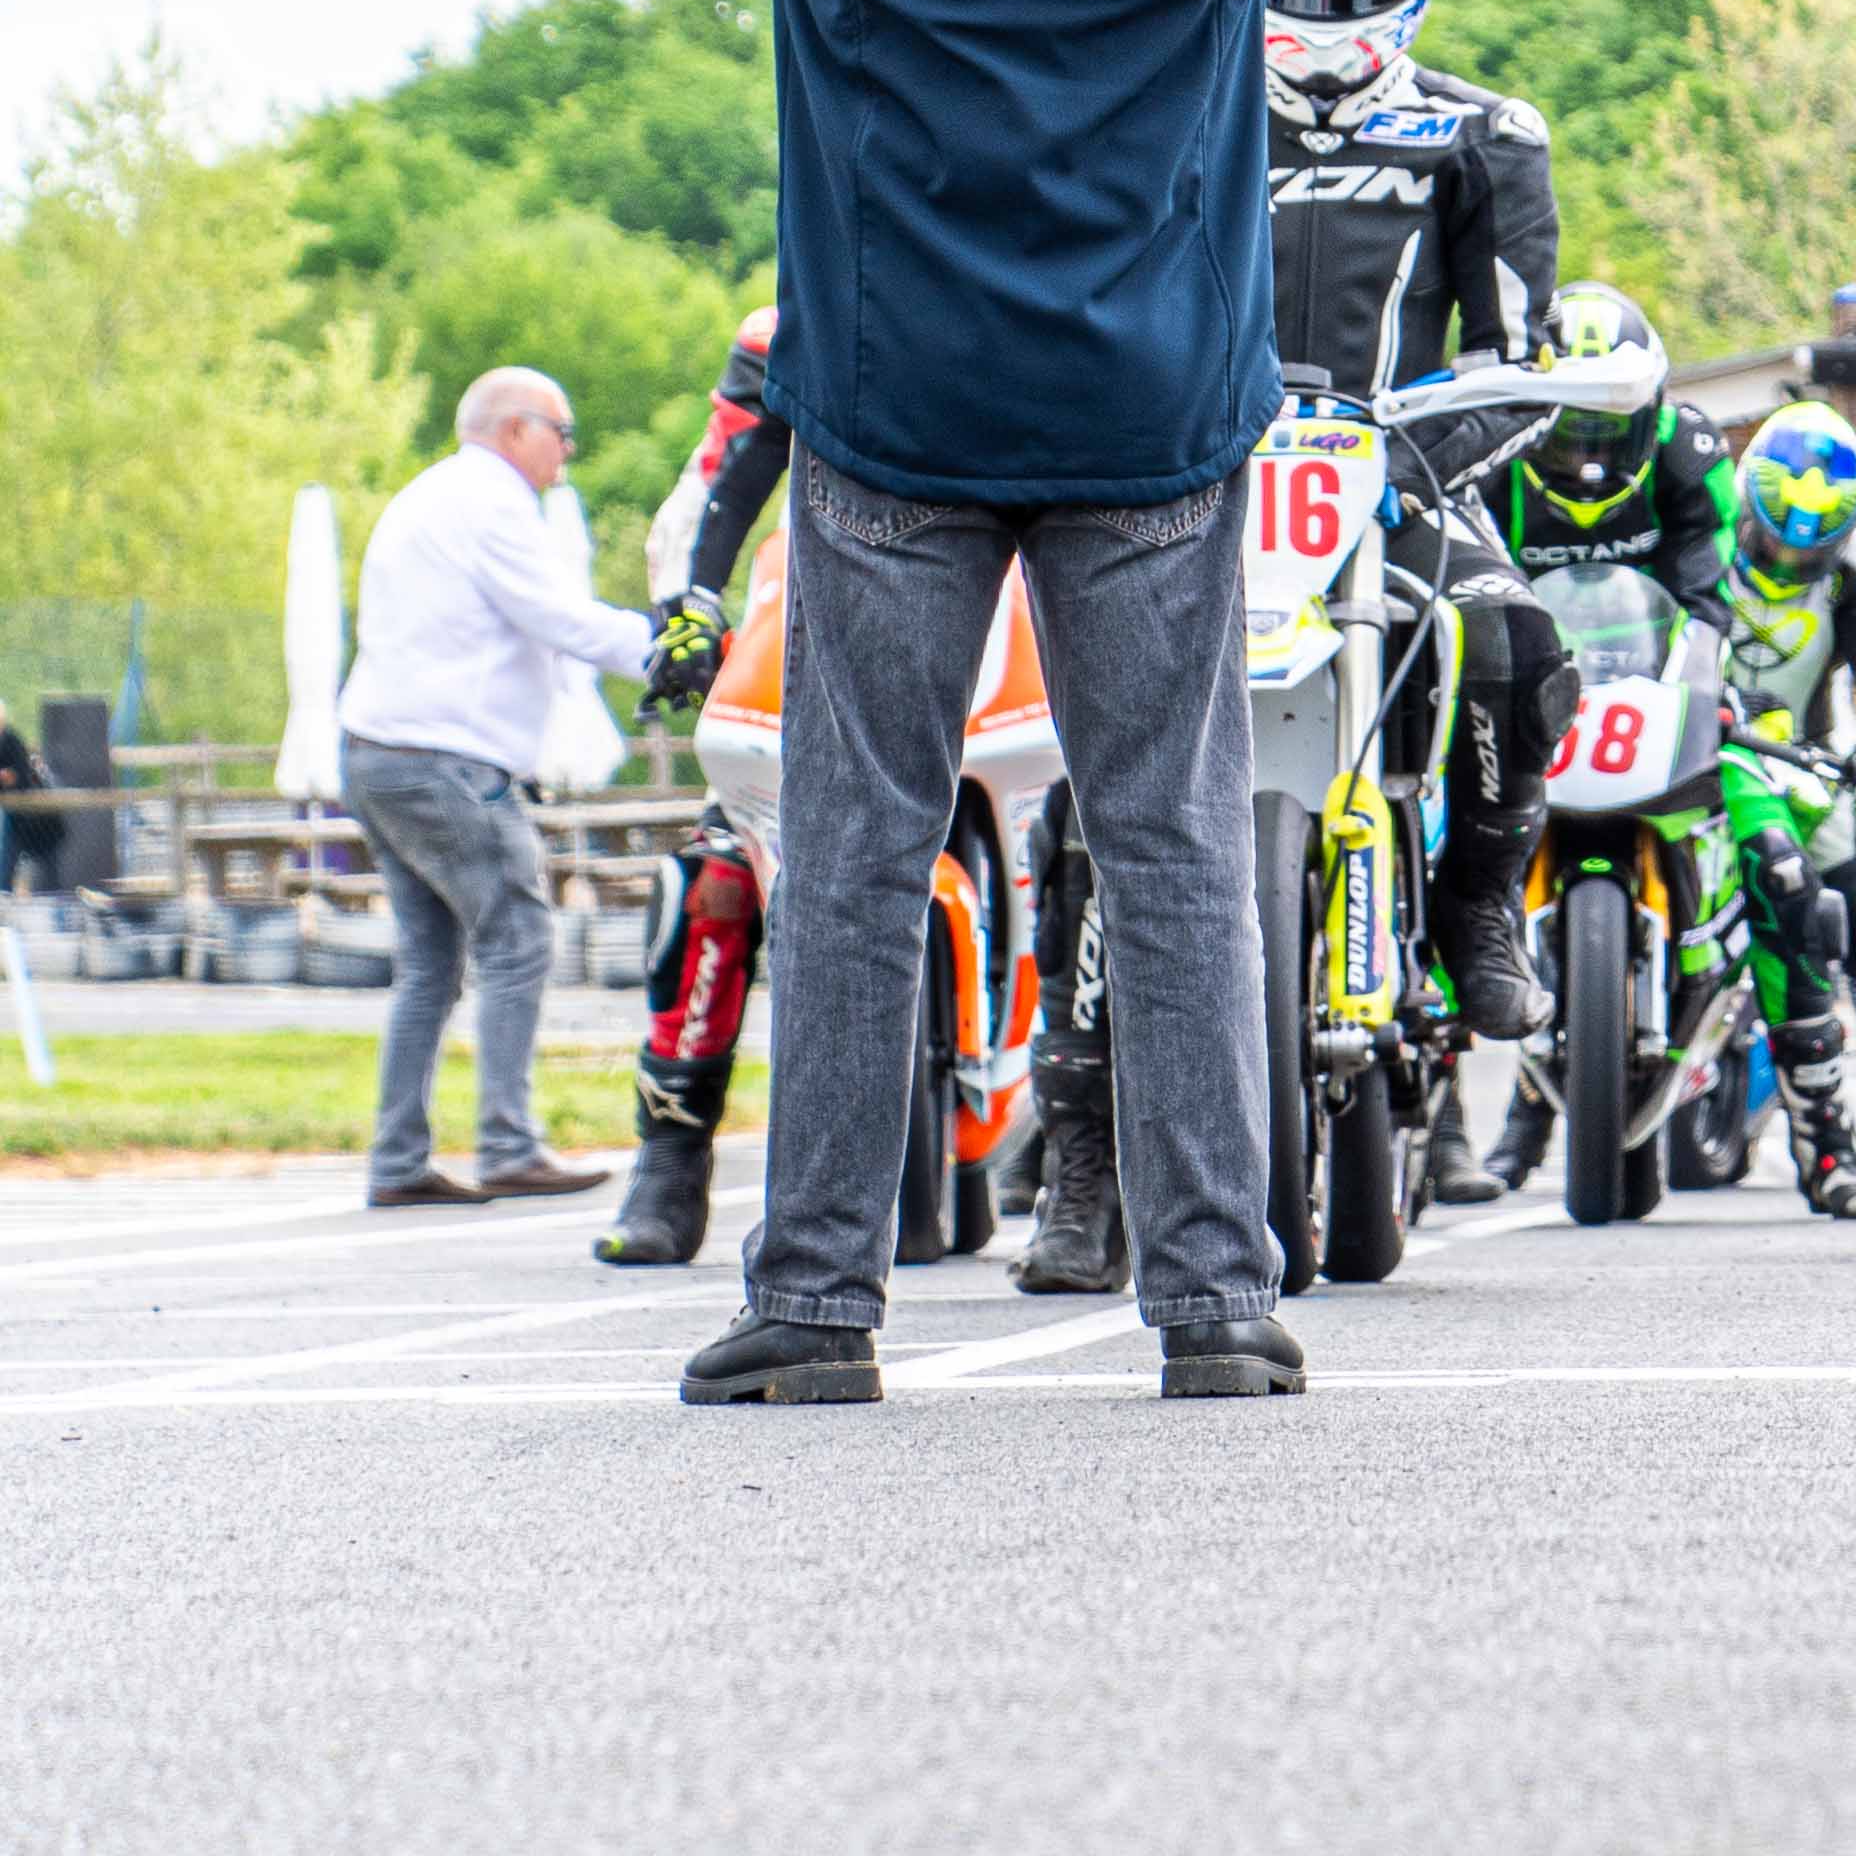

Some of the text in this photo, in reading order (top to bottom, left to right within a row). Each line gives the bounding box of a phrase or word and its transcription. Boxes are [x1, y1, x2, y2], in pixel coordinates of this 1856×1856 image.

[1267, 165, 1435, 214] ON
[1260, 460, 1341, 558] 16
[1519, 529, 1662, 565] OCTANE
[1468, 700, 1501, 804] IXON
[1347, 853, 1370, 992] DUNLOP
